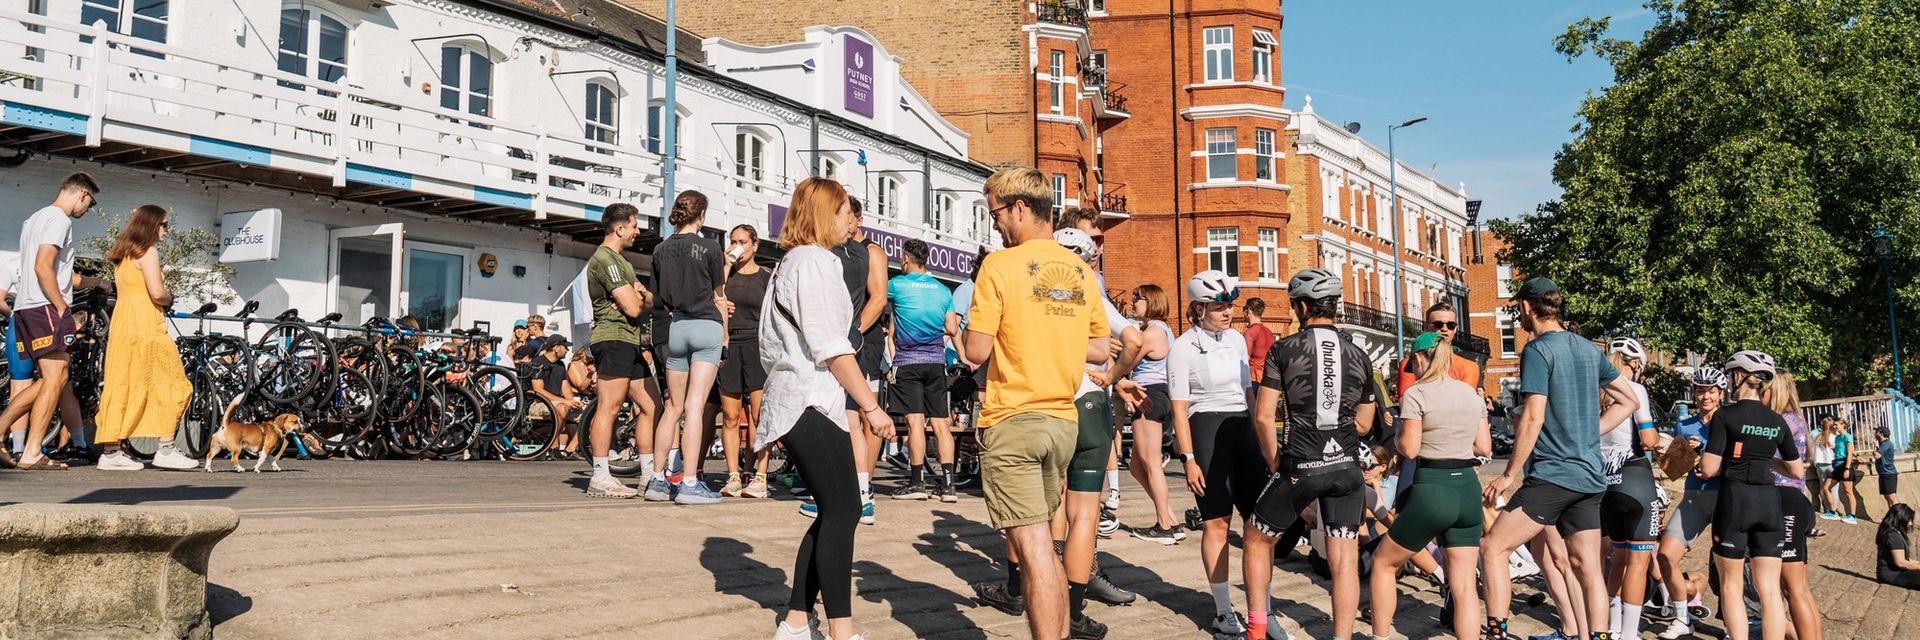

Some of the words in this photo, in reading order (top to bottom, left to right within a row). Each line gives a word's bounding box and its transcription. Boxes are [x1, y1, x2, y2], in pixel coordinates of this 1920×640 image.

[848, 68, 872, 84] PUTNEY
[858, 81, 871, 90] SCHOOL
[237, 227, 251, 236] THE
[223, 235, 264, 247] CLUBHOUSE
[871, 232, 903, 258] HIGH
[957, 253, 974, 273] GD
[1045, 303, 1076, 317] Parlez
[1321, 340, 1336, 388] Qhubeka
[1741, 424, 1779, 440] maap
